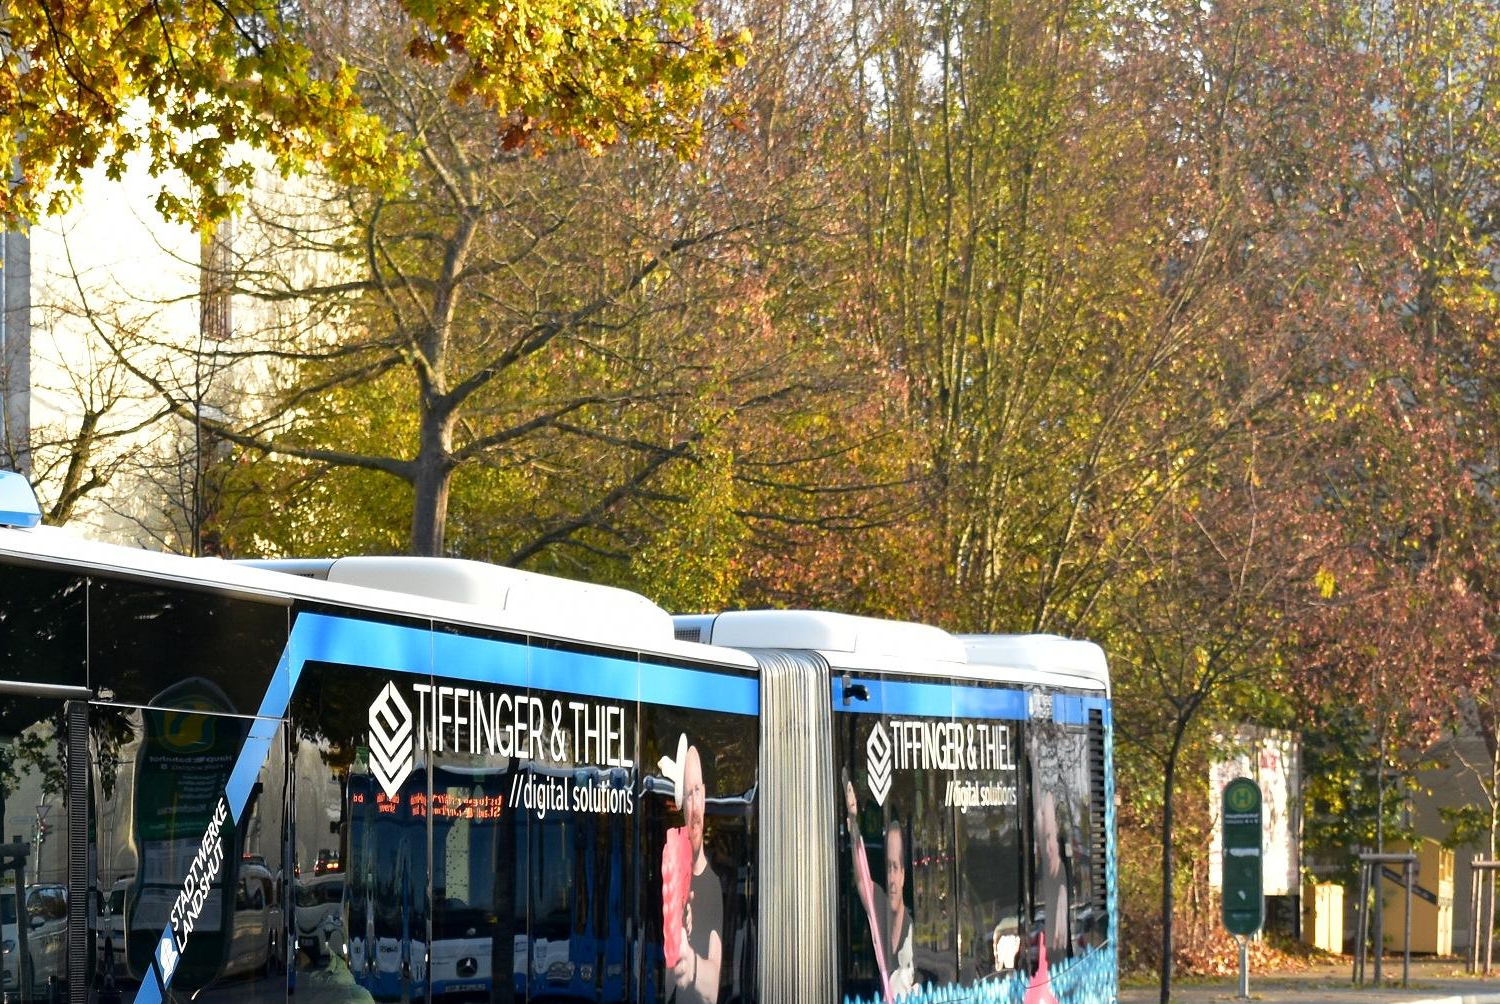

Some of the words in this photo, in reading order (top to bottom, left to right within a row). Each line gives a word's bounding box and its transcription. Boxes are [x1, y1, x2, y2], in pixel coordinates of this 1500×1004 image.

[413, 683, 544, 761] TIFFINGER
[550, 700, 568, 762] &
[568, 701, 634, 768] THIEL
[889, 720, 965, 771] TIFFINGER
[966, 723, 978, 770] &
[976, 723, 1016, 771] THIEL
[572, 783, 634, 816] solutions
[980, 780, 1017, 807] solutions
[170, 796, 228, 932] STADTWERKE
[176, 836, 224, 955] LANDSHUT
